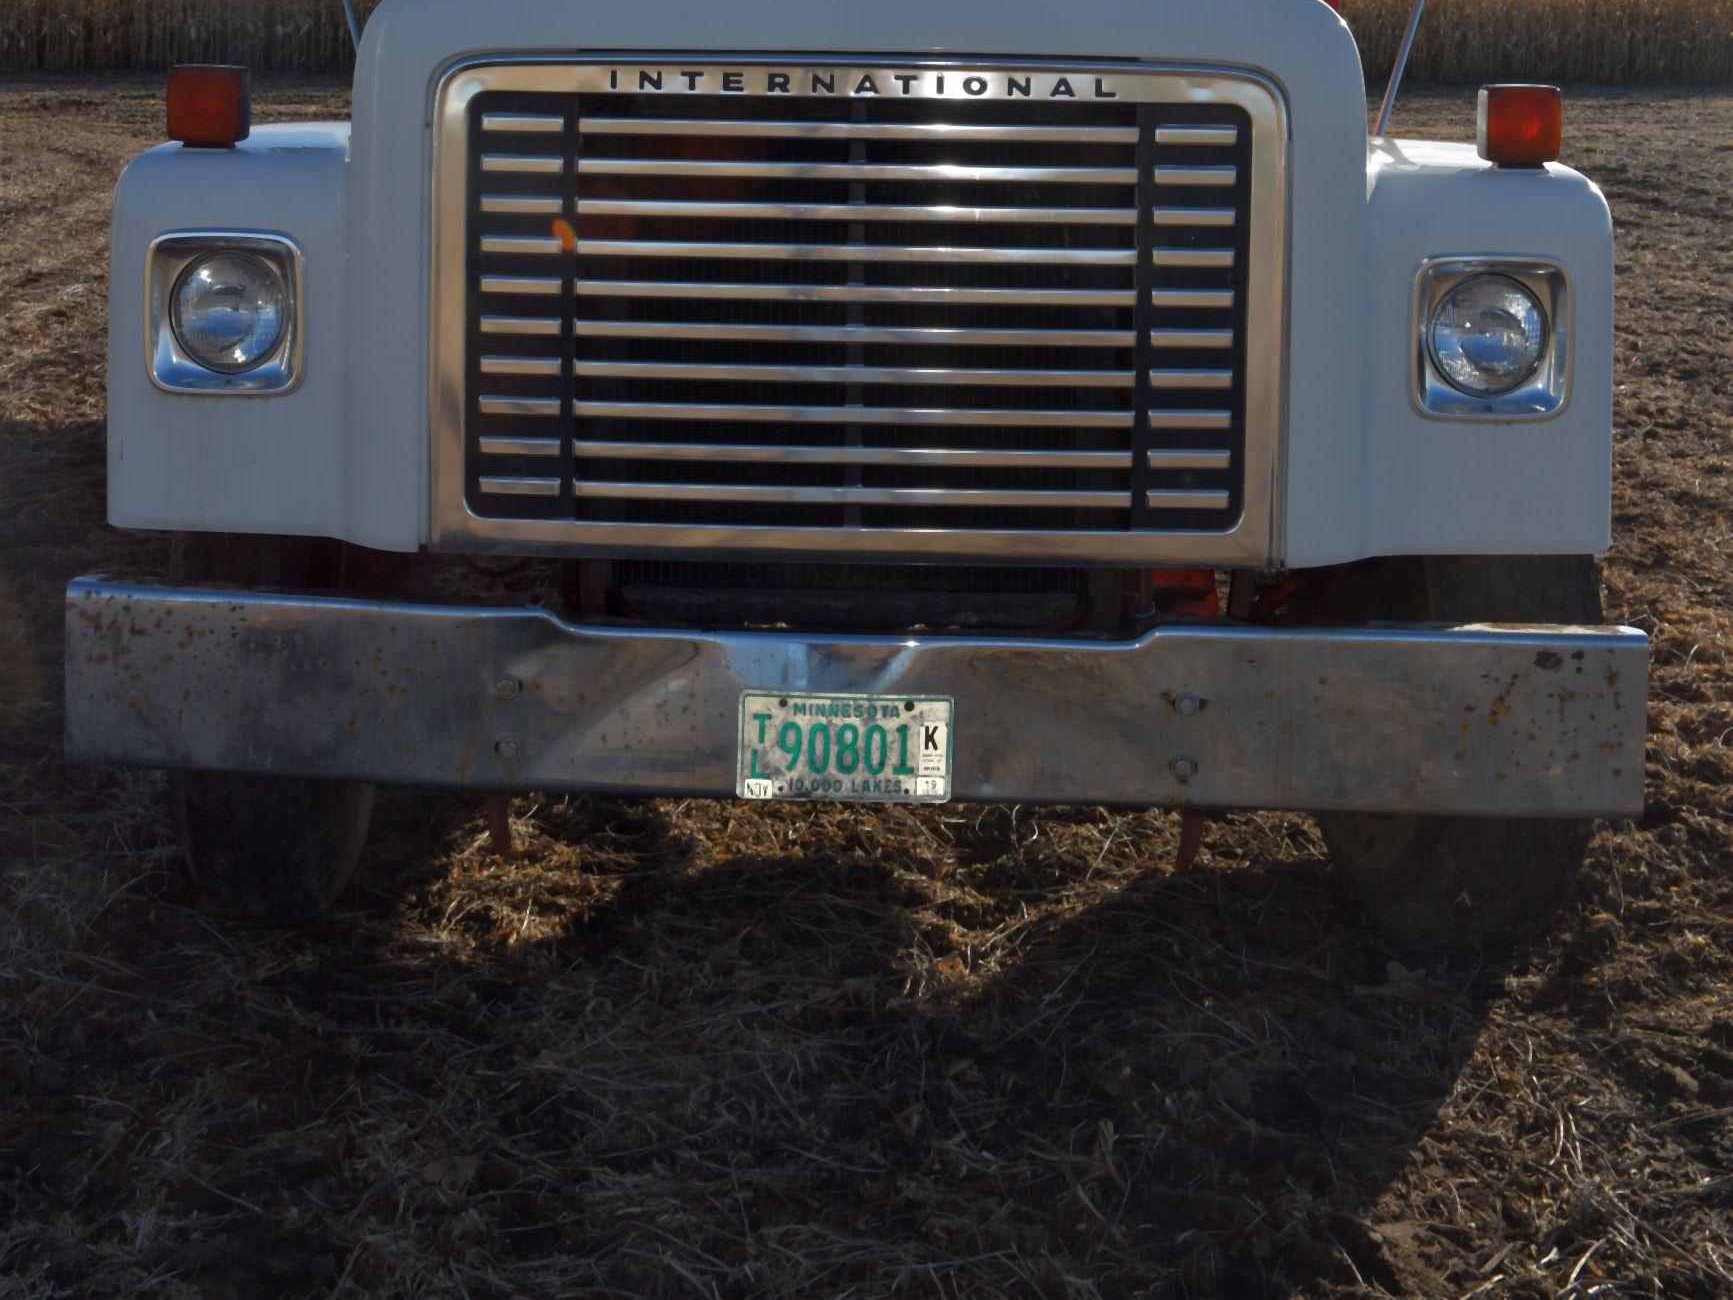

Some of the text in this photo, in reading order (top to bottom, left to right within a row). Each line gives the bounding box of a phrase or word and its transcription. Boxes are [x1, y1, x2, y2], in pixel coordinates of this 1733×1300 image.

[610, 69, 1118, 99] INTERNATIONAL
[792, 702, 901, 719] MINNESOTA
[778, 721, 914, 775] 90801
[924, 725, 939, 751] K
[851, 779, 903, 795] LAKES
